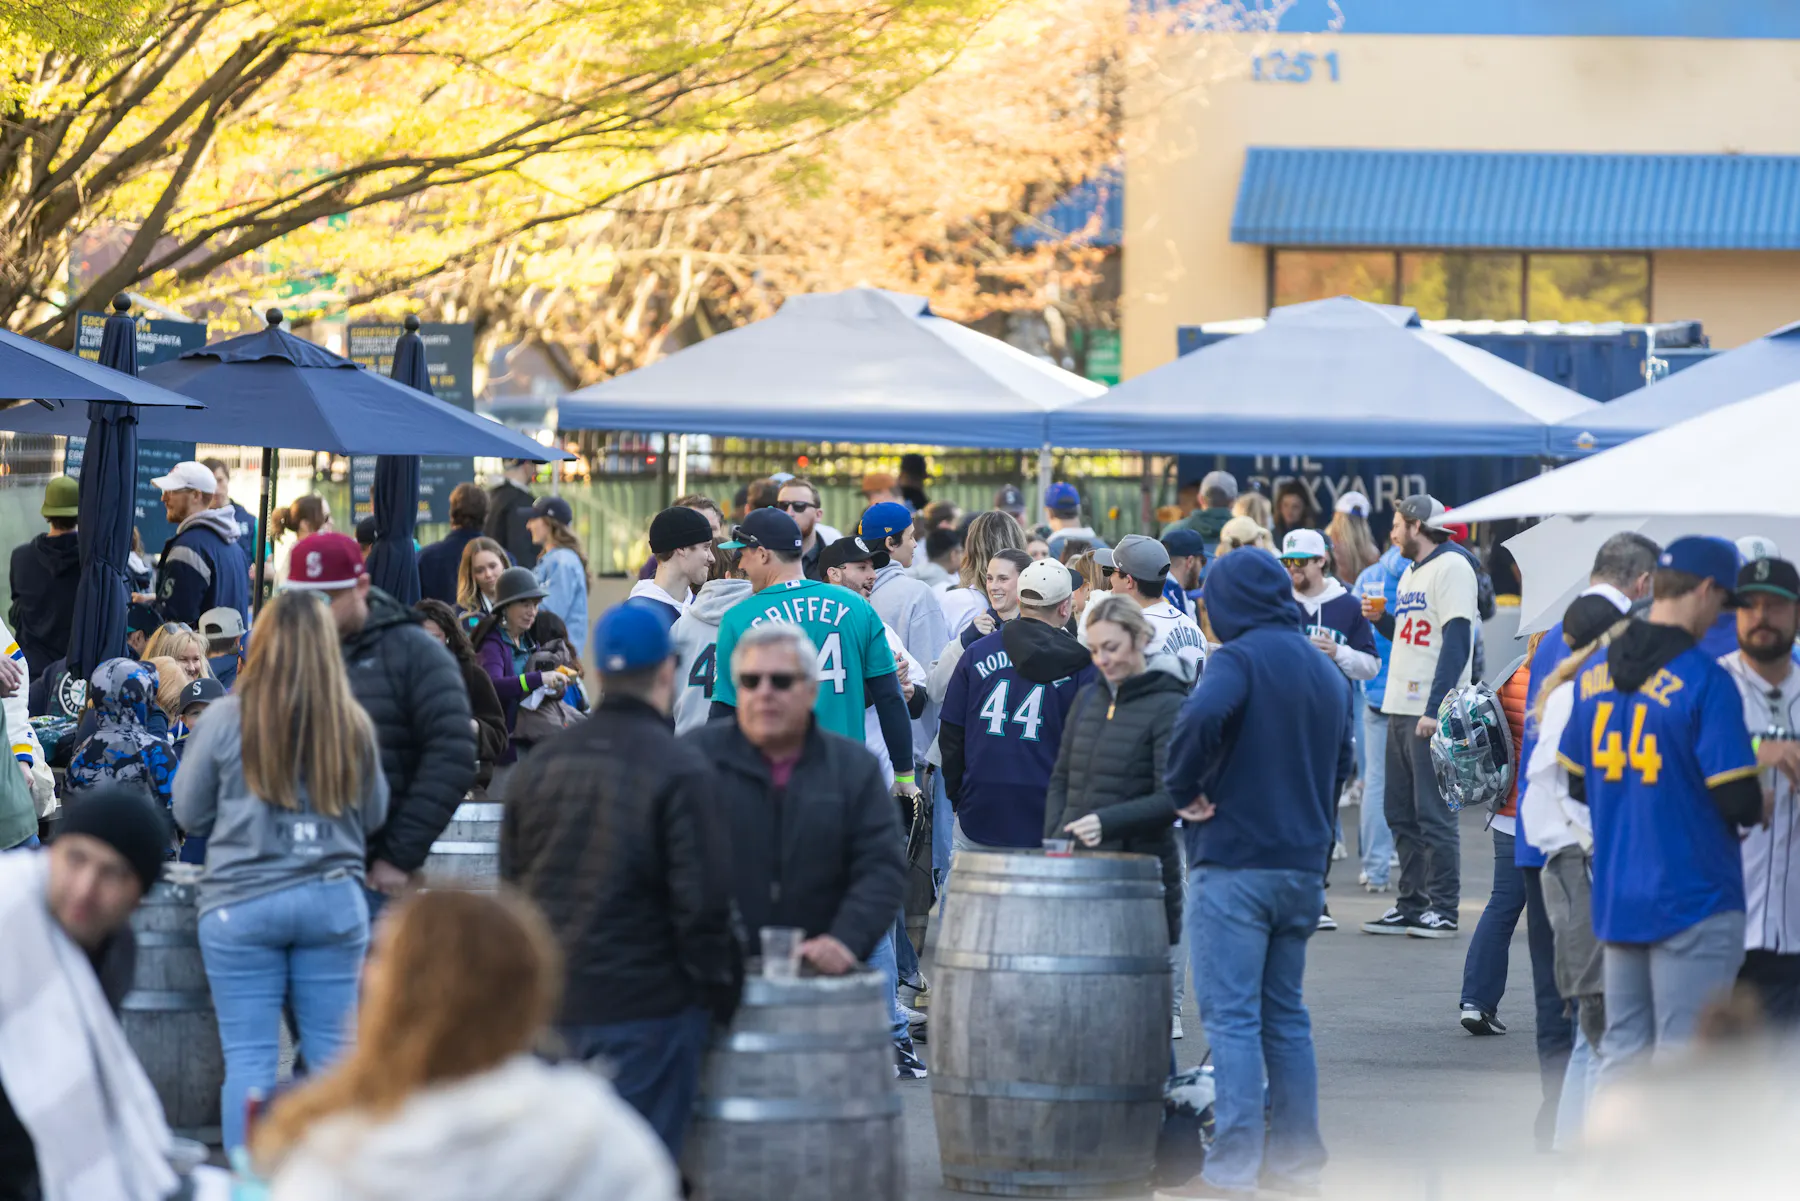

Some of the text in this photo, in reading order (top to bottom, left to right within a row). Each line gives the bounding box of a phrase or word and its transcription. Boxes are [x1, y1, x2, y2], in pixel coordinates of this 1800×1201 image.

[1248, 474, 1427, 513] XYARD
[306, 551, 322, 578] S
[1400, 617, 1432, 647] 42
[192, 681, 202, 696] S
[979, 678, 1046, 742] 44
[1591, 701, 1663, 783] 44
